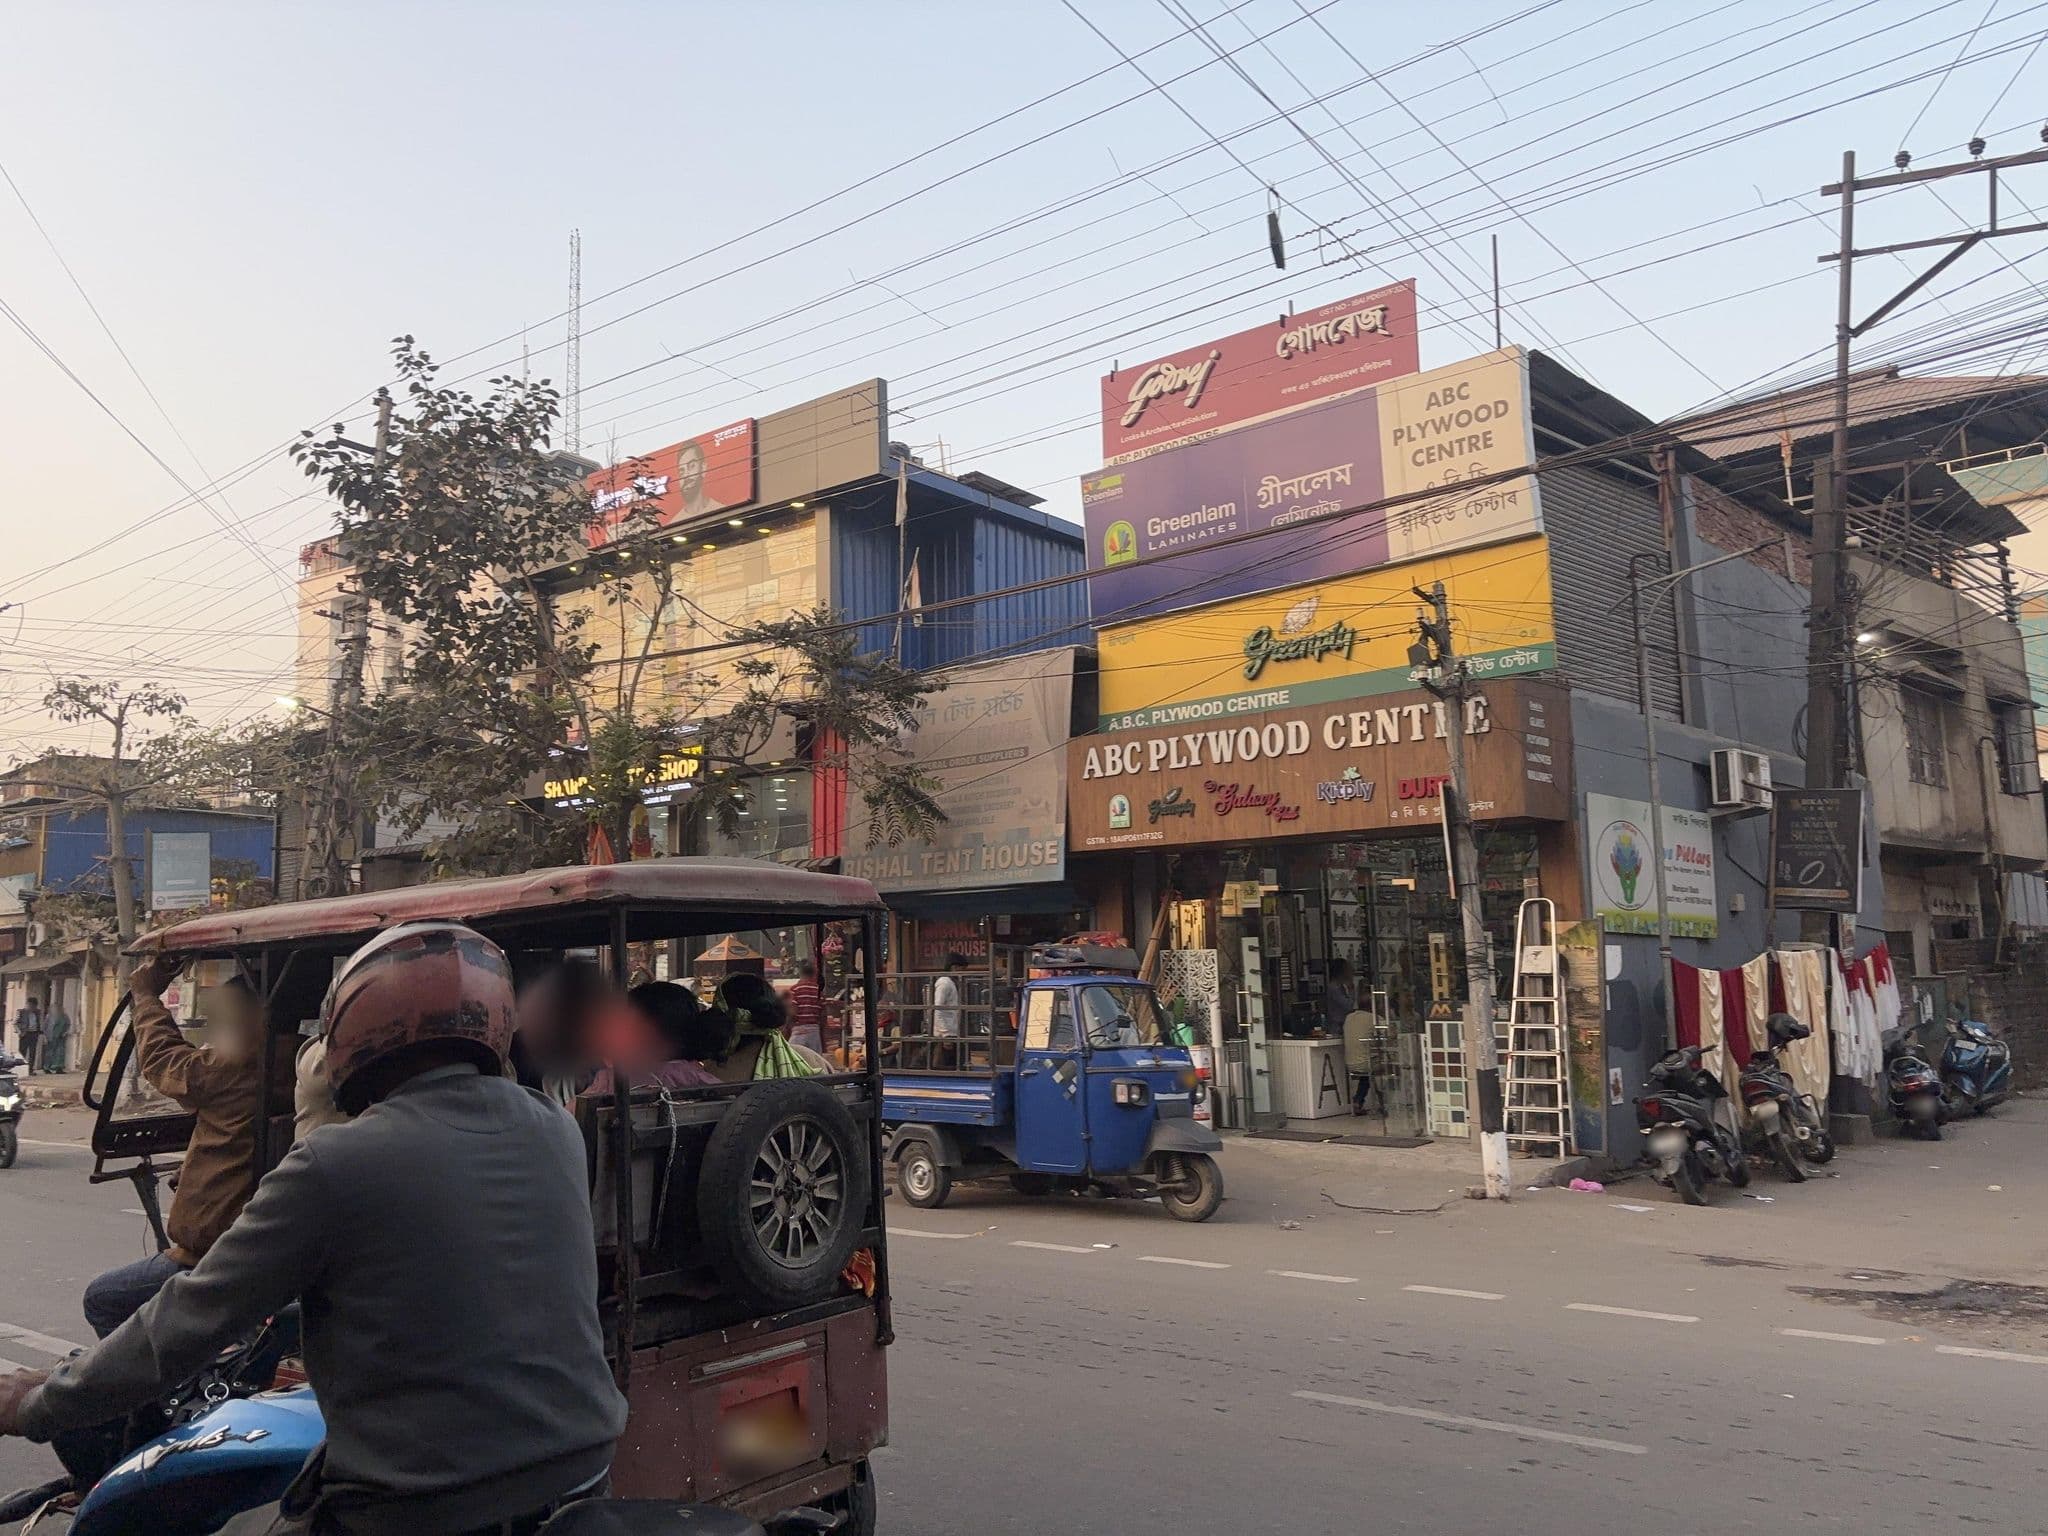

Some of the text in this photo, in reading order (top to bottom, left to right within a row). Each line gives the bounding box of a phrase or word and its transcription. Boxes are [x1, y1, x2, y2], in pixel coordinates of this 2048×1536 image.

[1425, 381, 1470, 411] ABC
[1392, 399, 1510, 447] PLYWOOD
[1411, 430, 1494, 467] CENTRE
[1147, 502, 1236, 537] Greenlam
[1148, 521, 1237, 551] LAMINATES
[1108, 690, 1290, 731] A.B.C. PLYWOOD CENTRE
[978, 748, 1026, 764] SUPPLIERS
[1082, 741, 1143, 780] ABC
[1147, 719, 1311, 772] PLYWOOD
[1316, 779, 1376, 805] Kitply
[920, 848, 975, 876] TENT
[981, 840, 1059, 871] HOUSE
